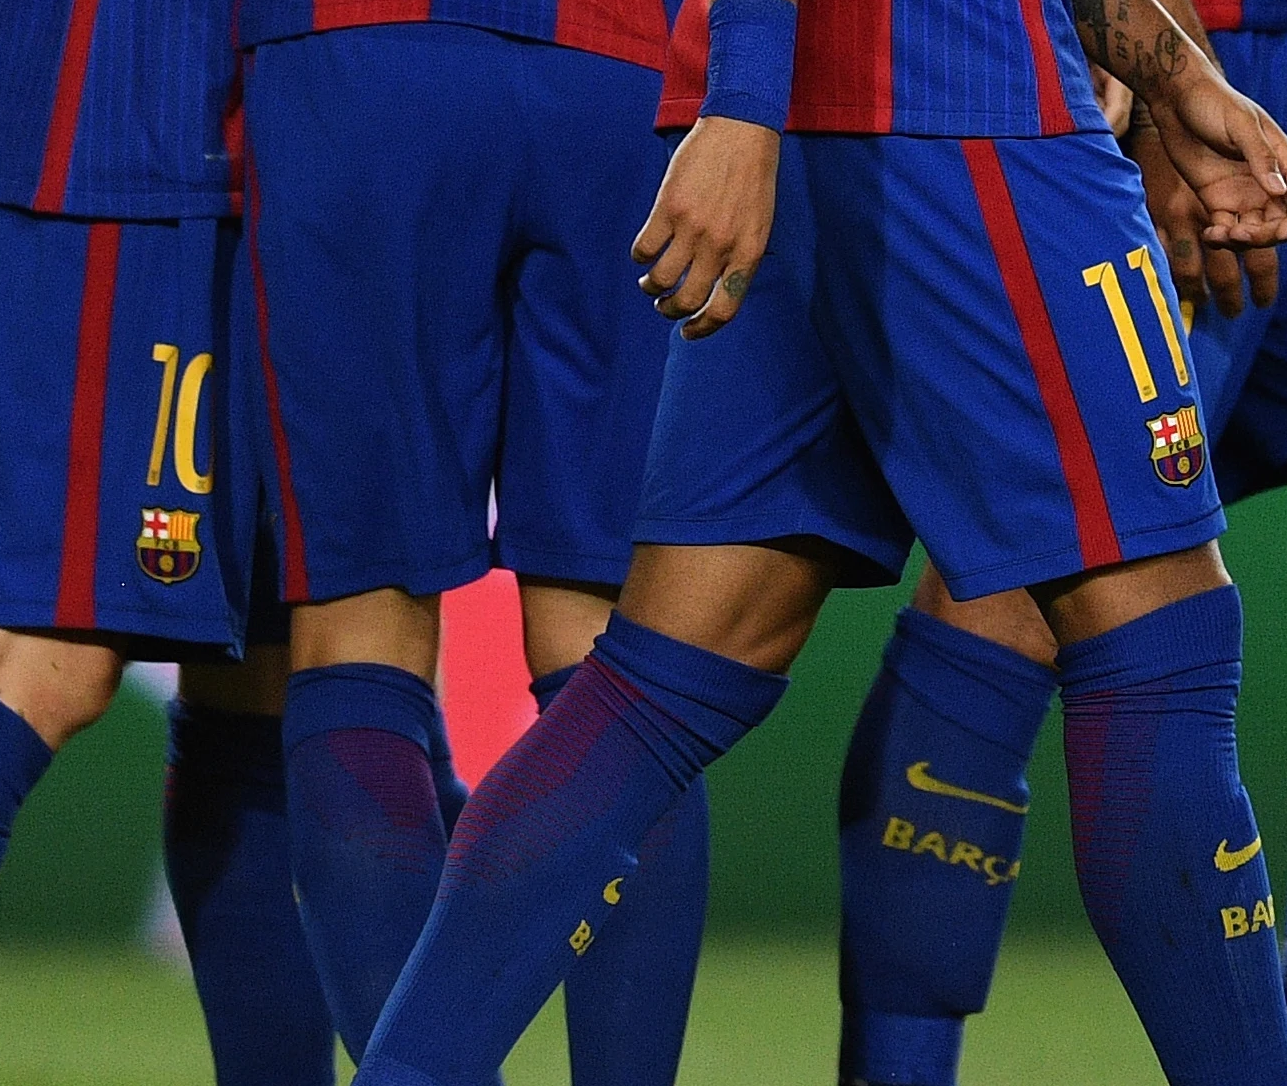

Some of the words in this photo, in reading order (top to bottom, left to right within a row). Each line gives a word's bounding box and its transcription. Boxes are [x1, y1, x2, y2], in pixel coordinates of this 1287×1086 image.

[1081, 243, 1189, 404] 11
[146, 342, 214, 494] 10
[1168, 439, 1190, 455] FCB
[1220, 894, 1275, 940] BA
